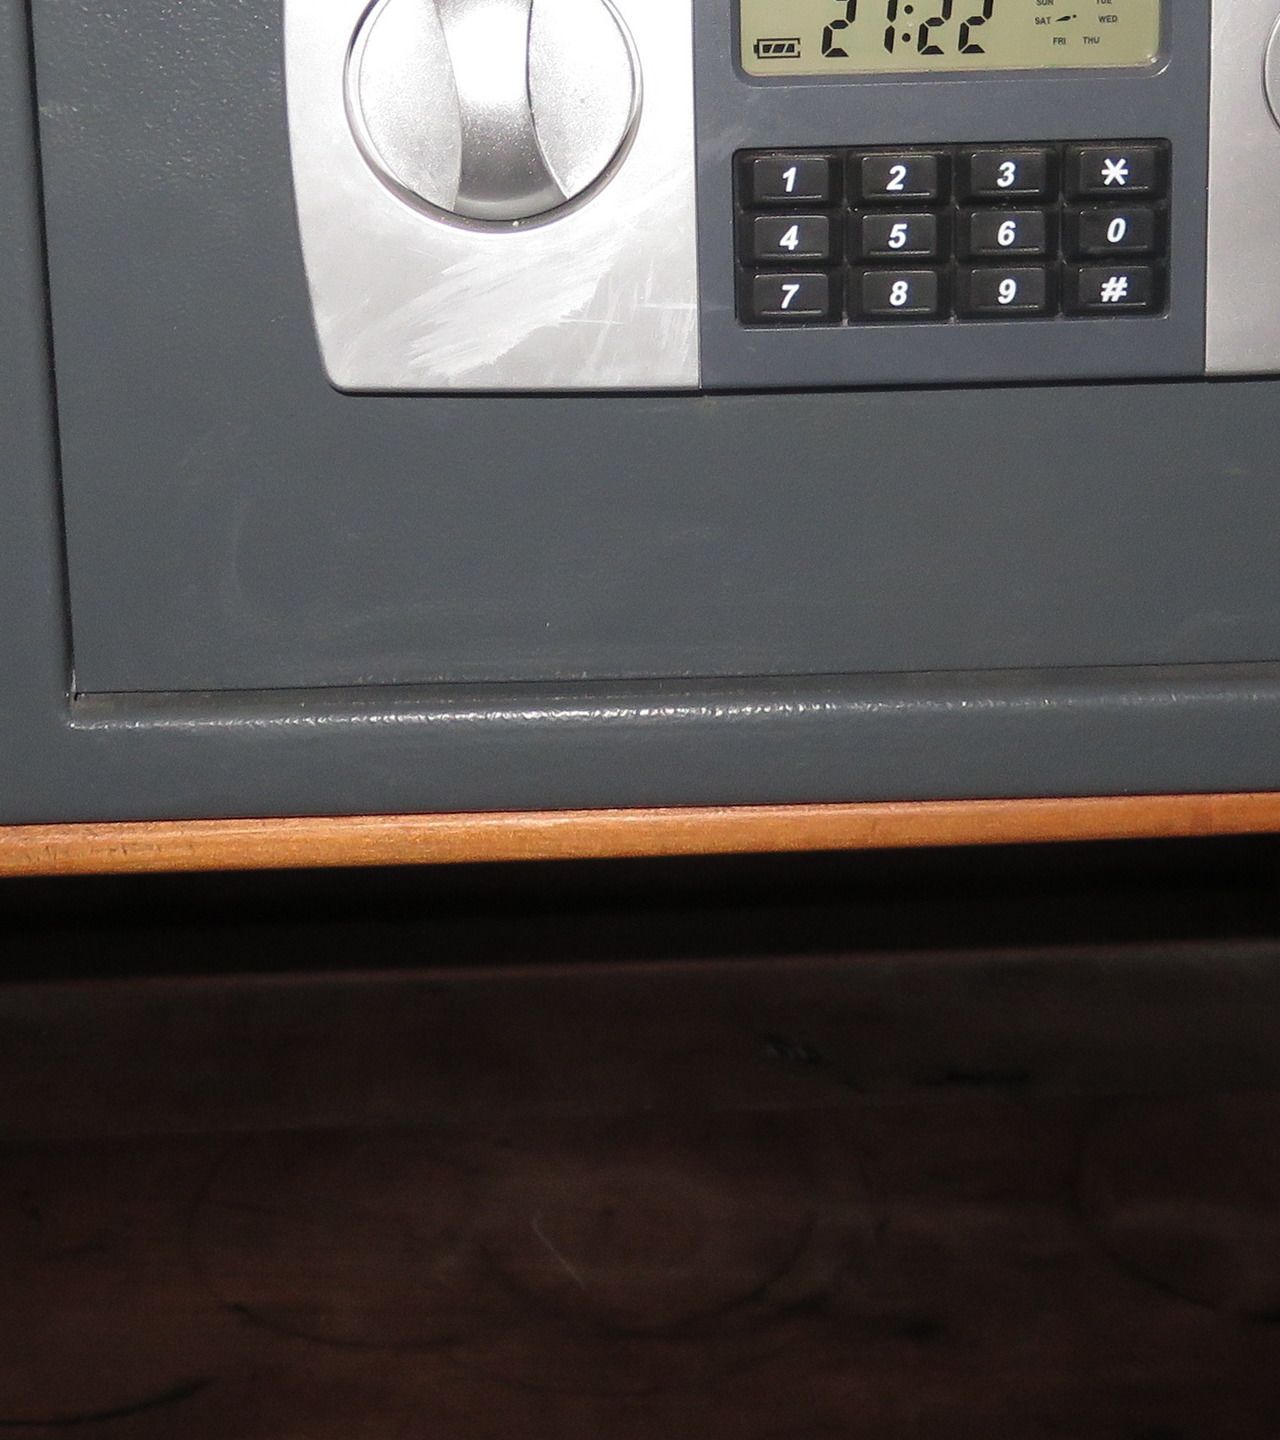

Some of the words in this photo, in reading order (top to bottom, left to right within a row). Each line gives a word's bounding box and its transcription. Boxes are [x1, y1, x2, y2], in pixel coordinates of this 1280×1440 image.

[1034, 16, 1052, 26] SAT
[1098, 14, 1119, 24] WED
[1052, 36, 1067, 46] FRI
[1082, 36, 1101, 45] THU
[782, 166, 797, 192] 1
[887, 165, 907, 191] 2
[997, 162, 1016, 188] 3
[780, 225, 798, 250] 4
[889, 224, 907, 248] 5
[998, 221, 1015, 245] 6
[1108, 218, 1125, 242] 0
[781, 284, 800, 309] 7
[890, 281, 908, 305] 8
[998, 279, 1016, 303] 9
[1101, 277, 1127, 302] #
